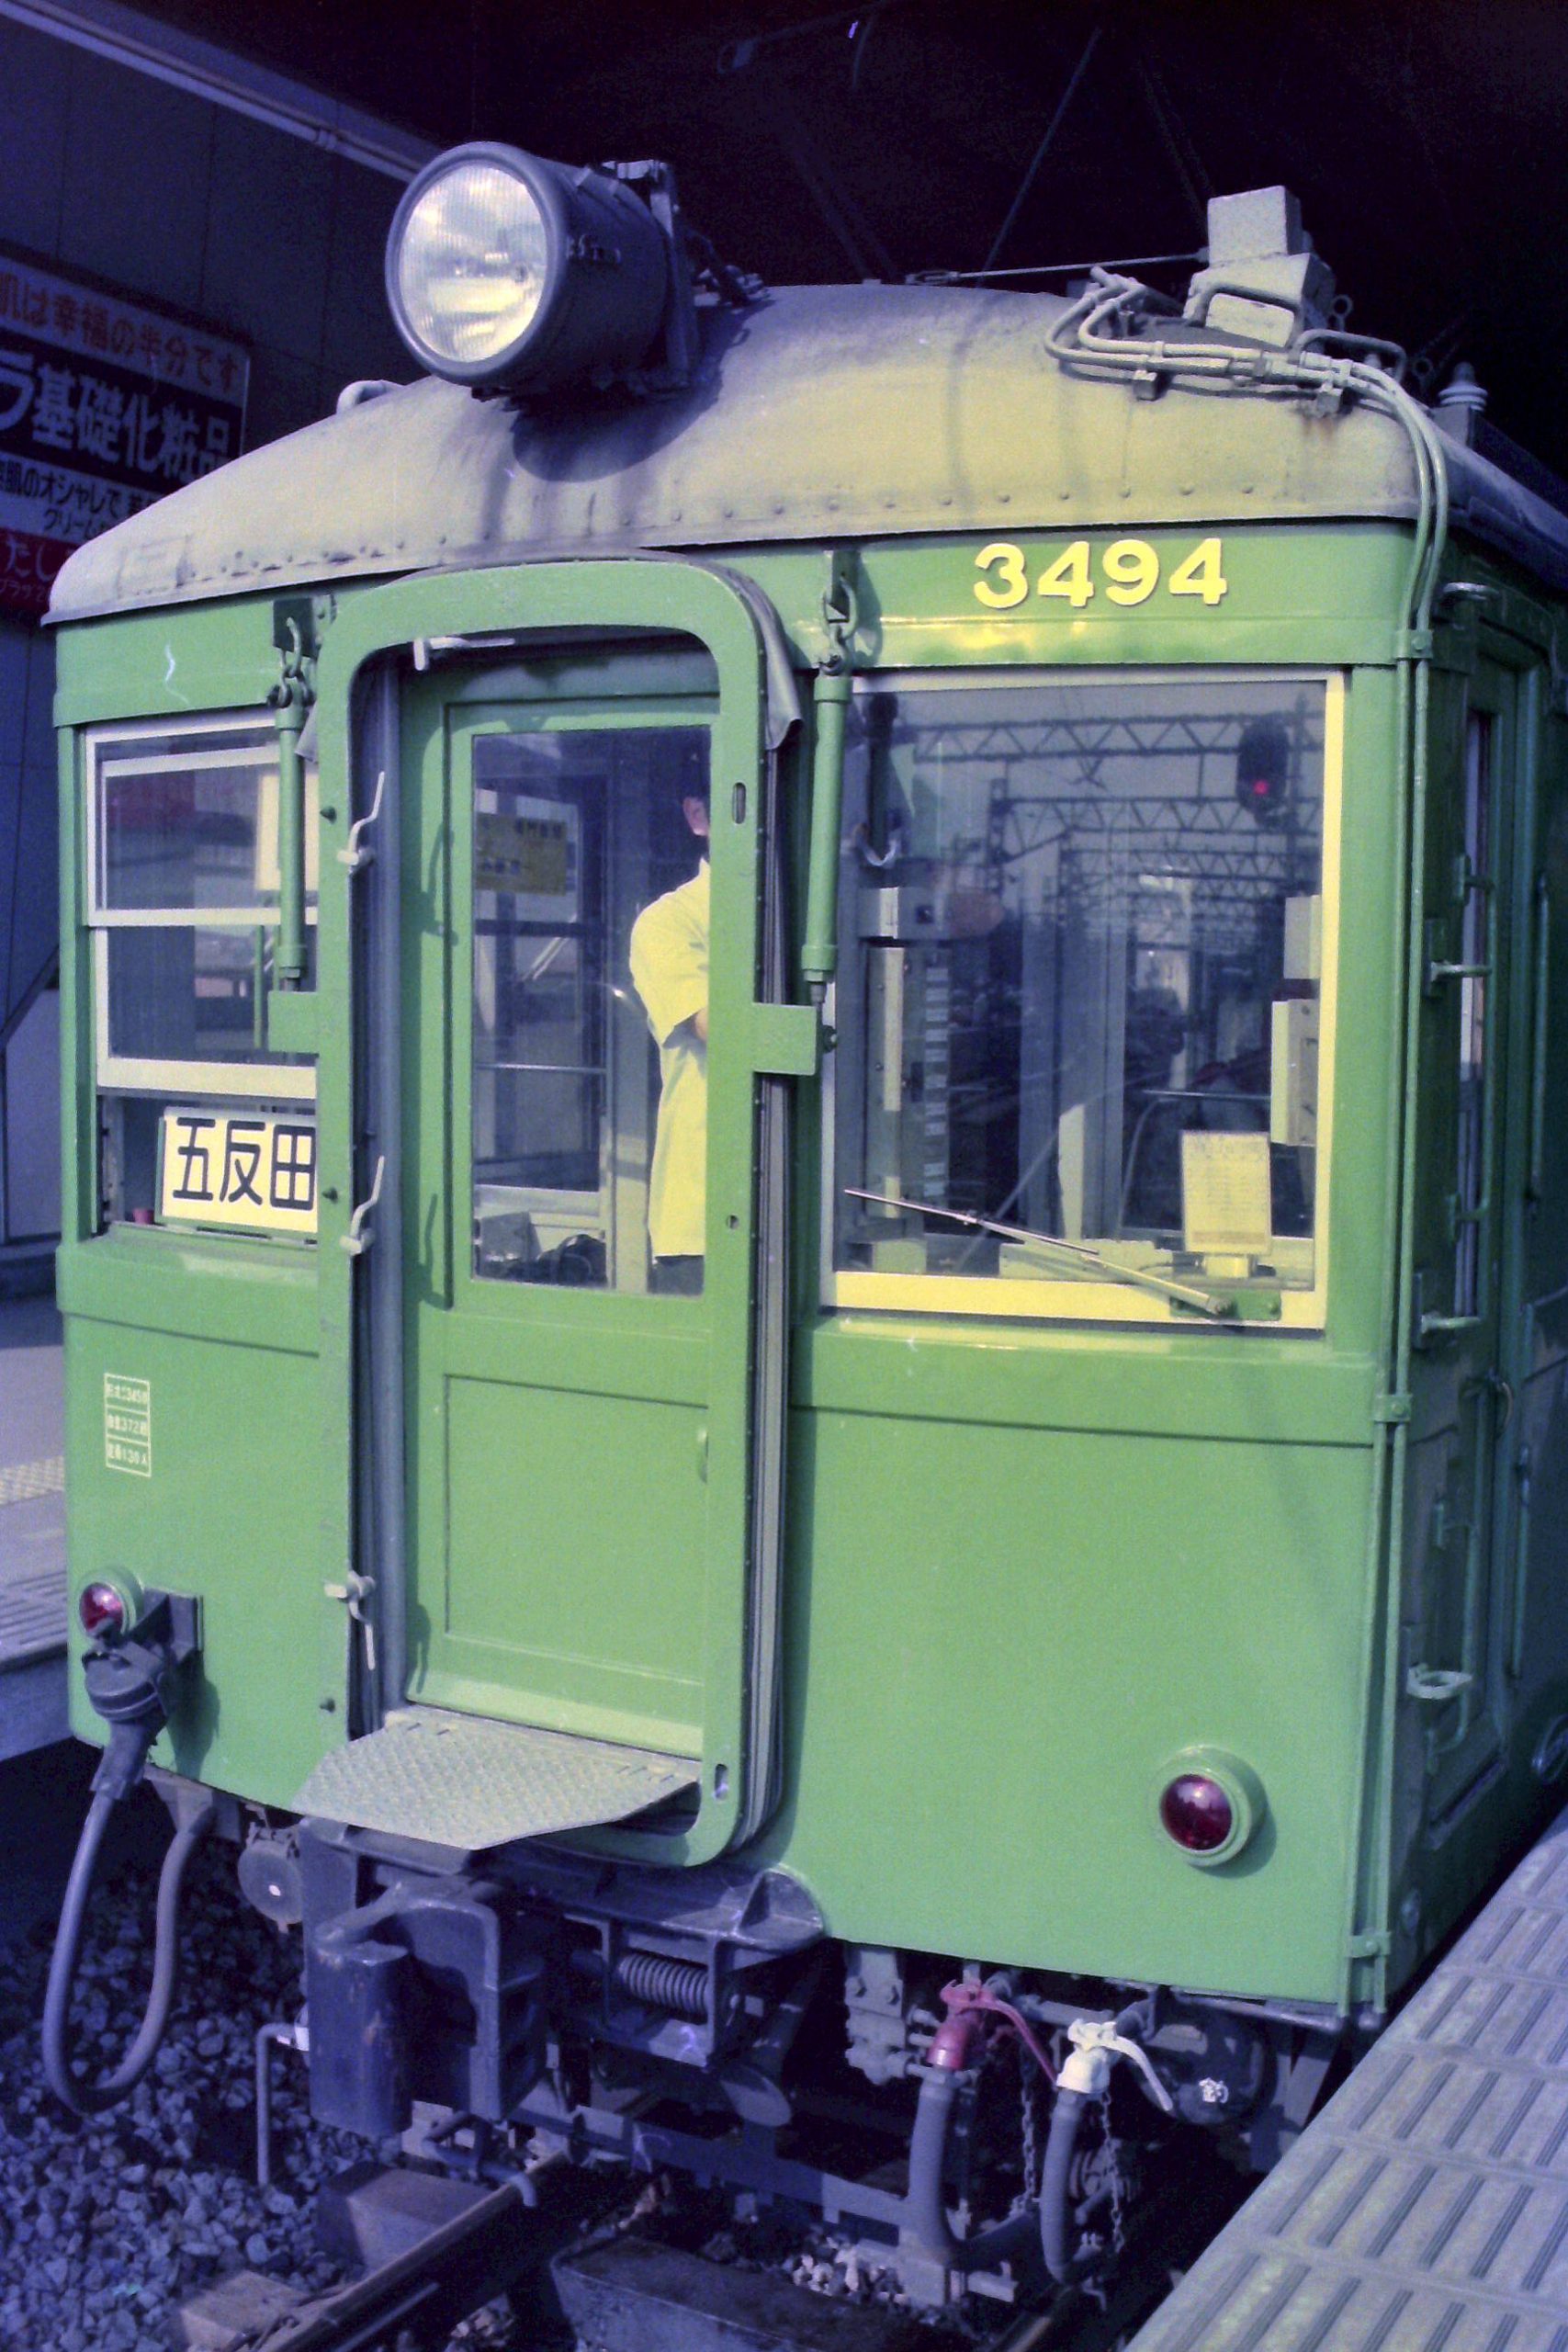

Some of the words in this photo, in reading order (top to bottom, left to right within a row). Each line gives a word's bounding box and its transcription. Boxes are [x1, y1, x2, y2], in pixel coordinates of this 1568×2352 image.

[974, 537, 1227, 608] 3494
[173, 1117, 316, 1211] 五反田
